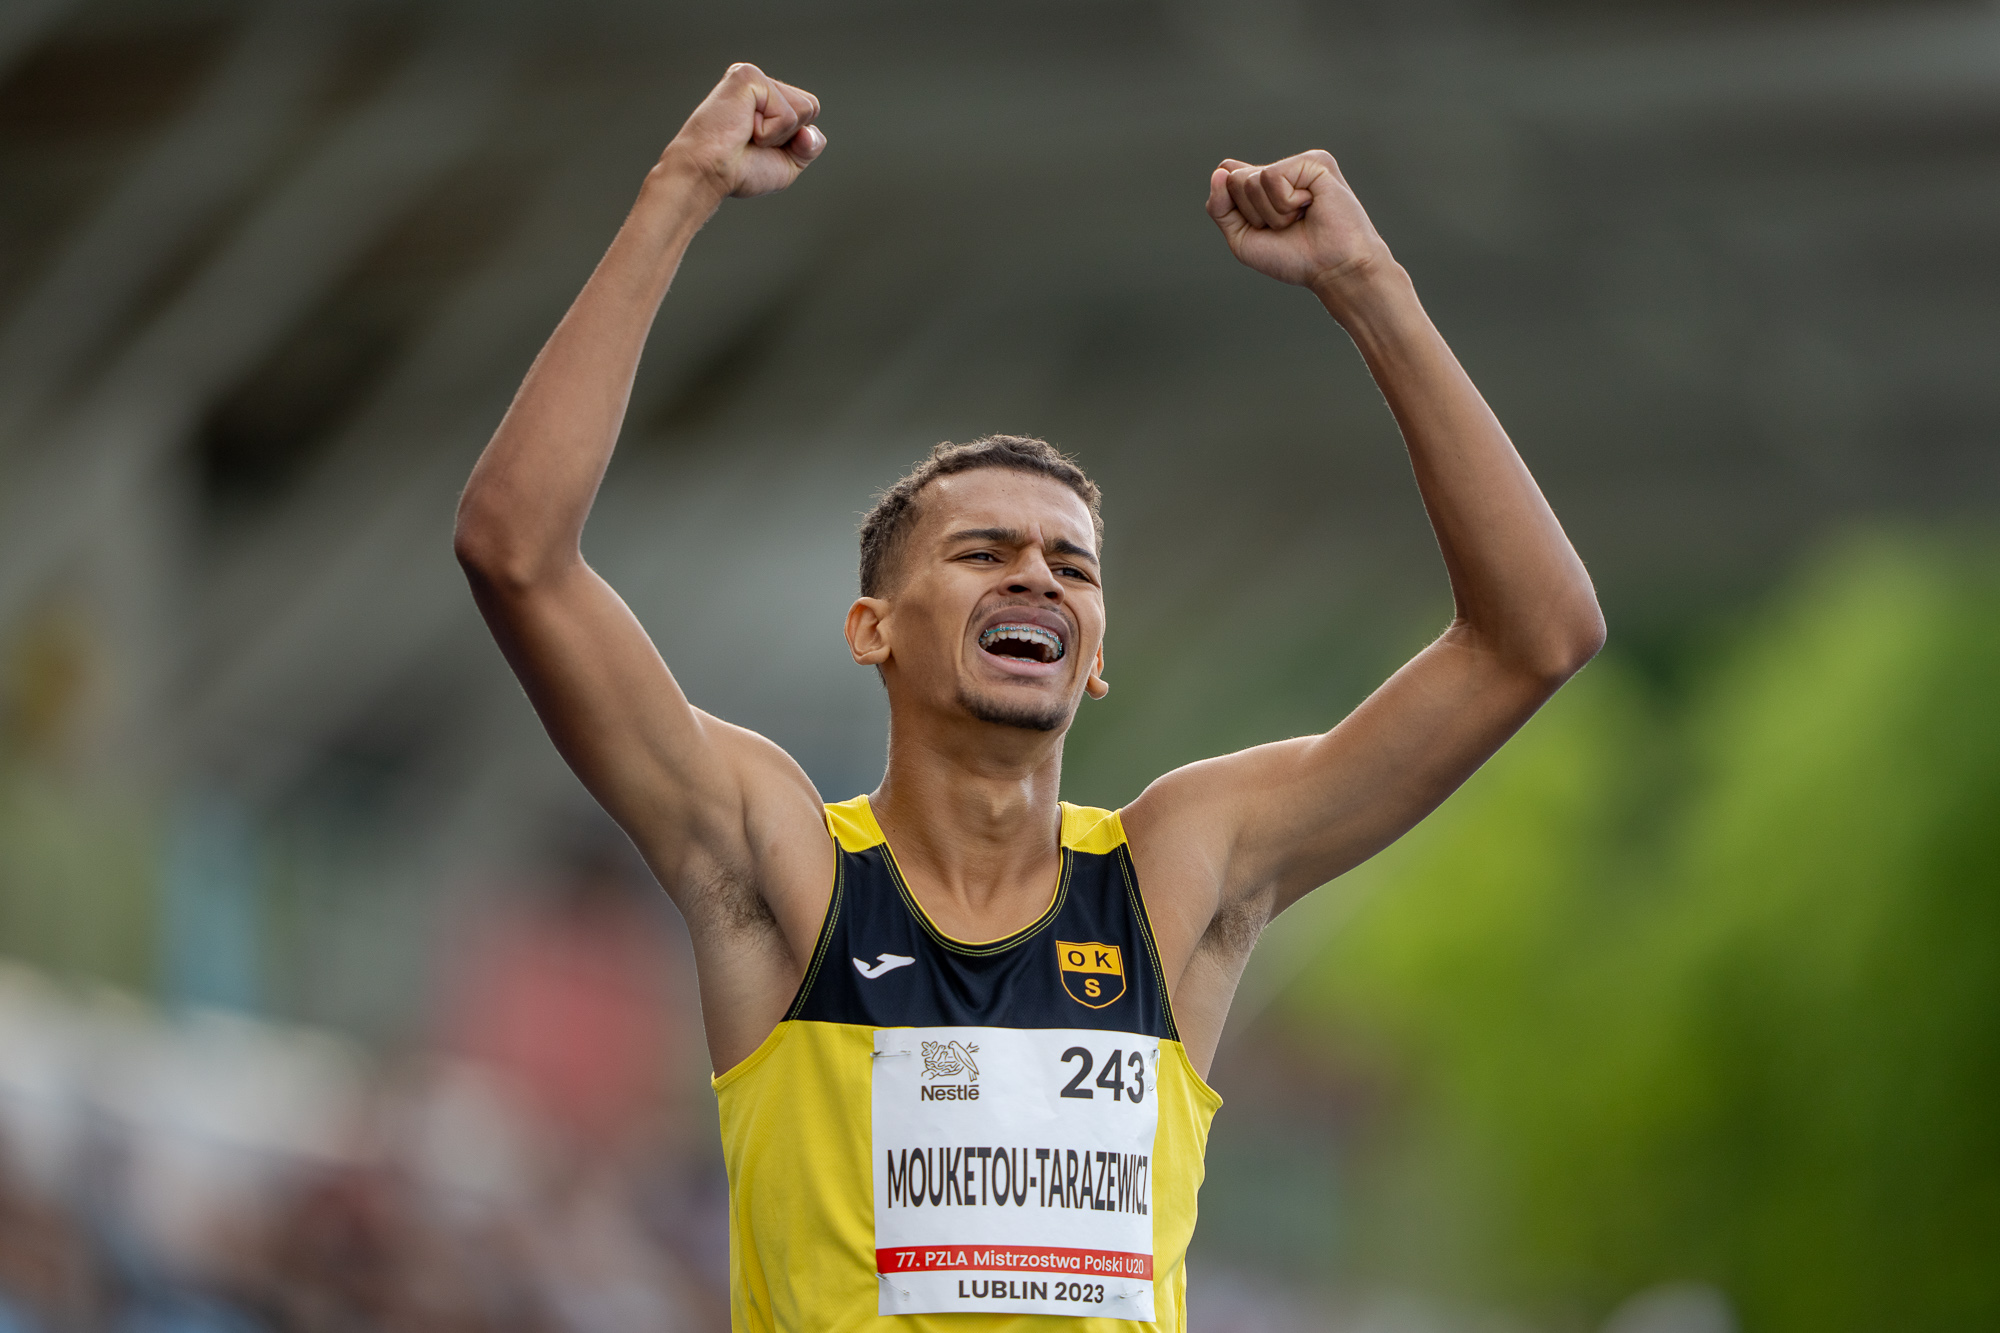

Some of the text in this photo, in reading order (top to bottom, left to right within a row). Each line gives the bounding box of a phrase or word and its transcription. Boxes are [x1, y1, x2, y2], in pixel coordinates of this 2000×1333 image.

[1060, 1046, 1145, 1104] 243
[887, 1146, 1148, 1215] MOUKETOU-TARAZEWICZ
[896, 1250, 1145, 1275] 77. PZLA Mistrzostwa Polski U20
[958, 1280, 1105, 1304] LUBLIN 2023
